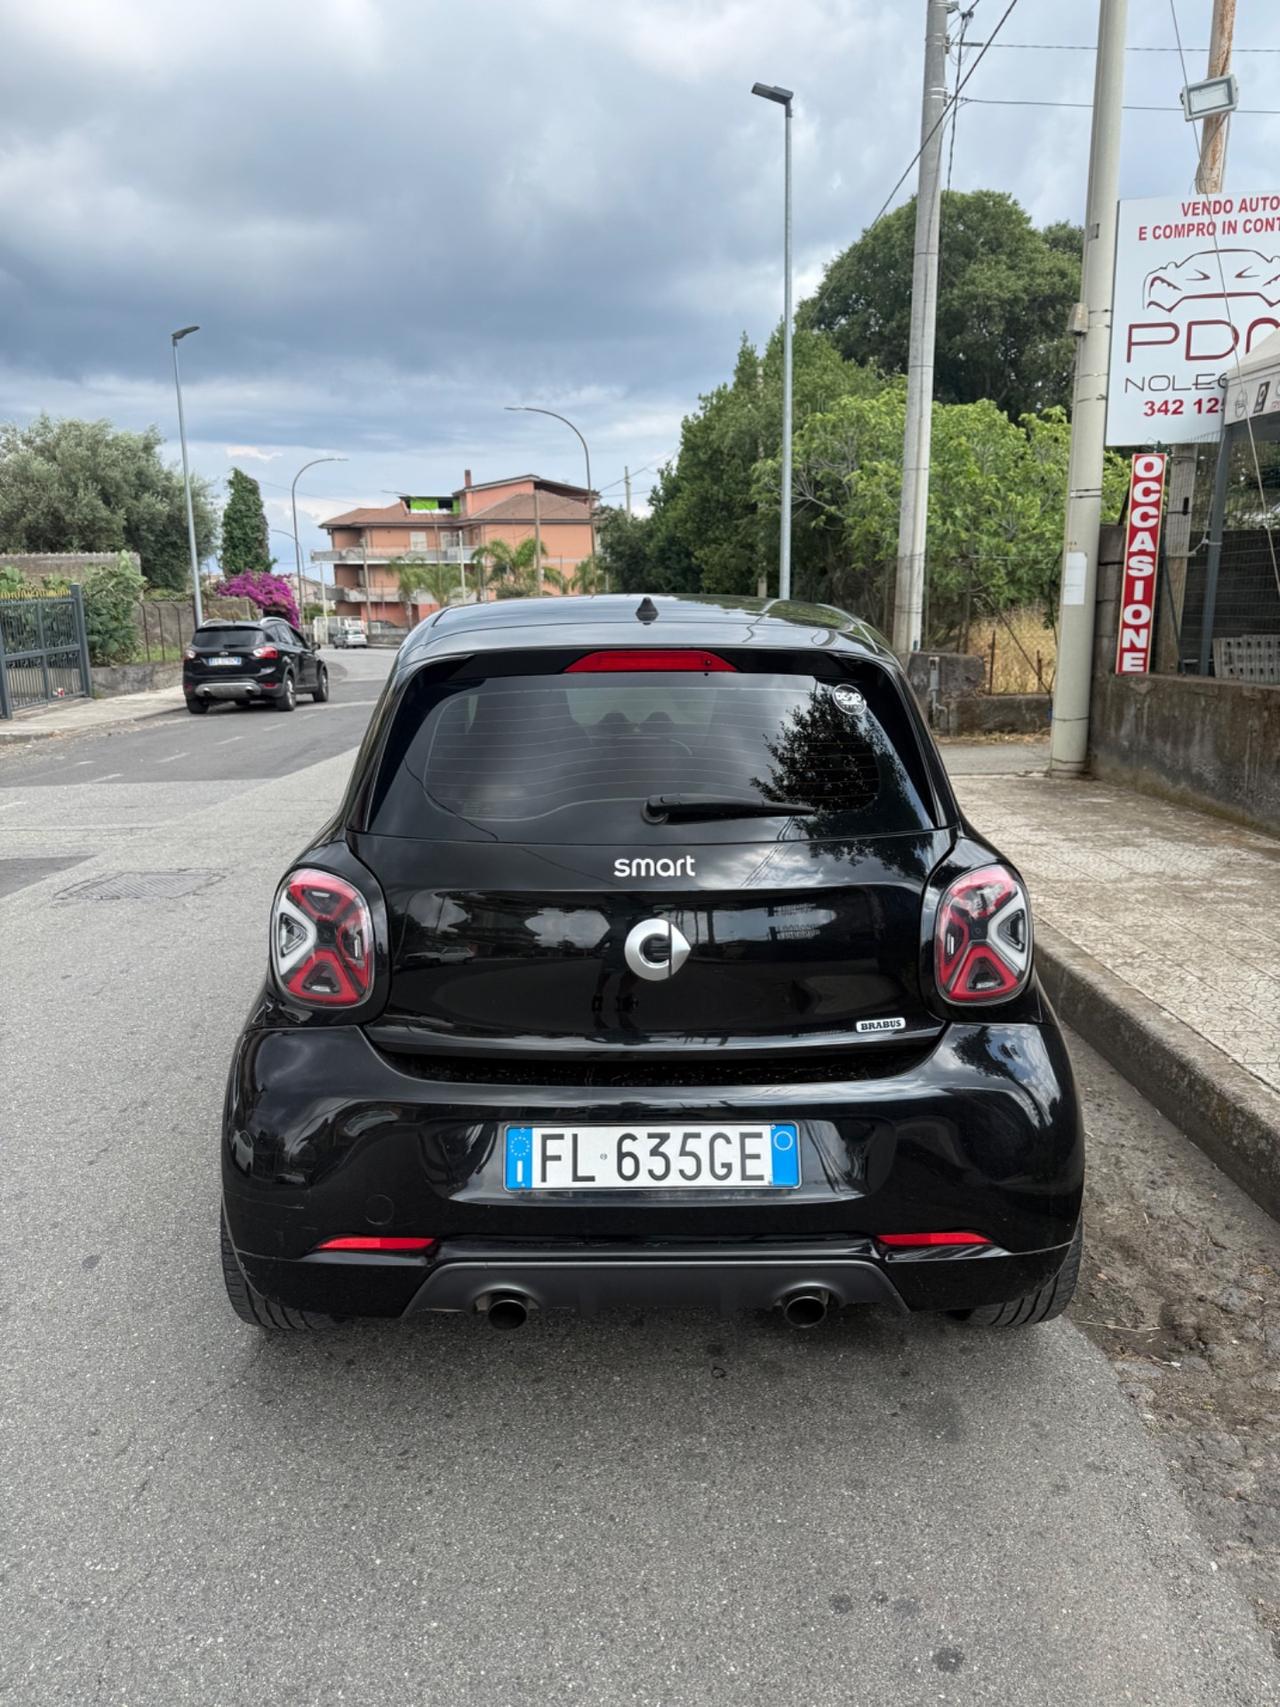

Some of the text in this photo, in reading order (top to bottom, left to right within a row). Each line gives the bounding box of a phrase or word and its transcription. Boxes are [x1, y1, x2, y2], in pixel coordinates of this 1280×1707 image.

[1181, 195, 1280, 217] VENDO AUTO
[1138, 225, 1148, 241] E
[1152, 220, 1217, 240] COMPRO
[1222, 219, 1237, 235] IN
[1143, 397, 1225, 417] 342 12
[1121, 456, 1164, 672] OCCASIONE
[613, 855, 697, 878] smart
[860, 1019, 902, 1031] BRABUS
[540, 1131, 765, 1183] FL 635GE
